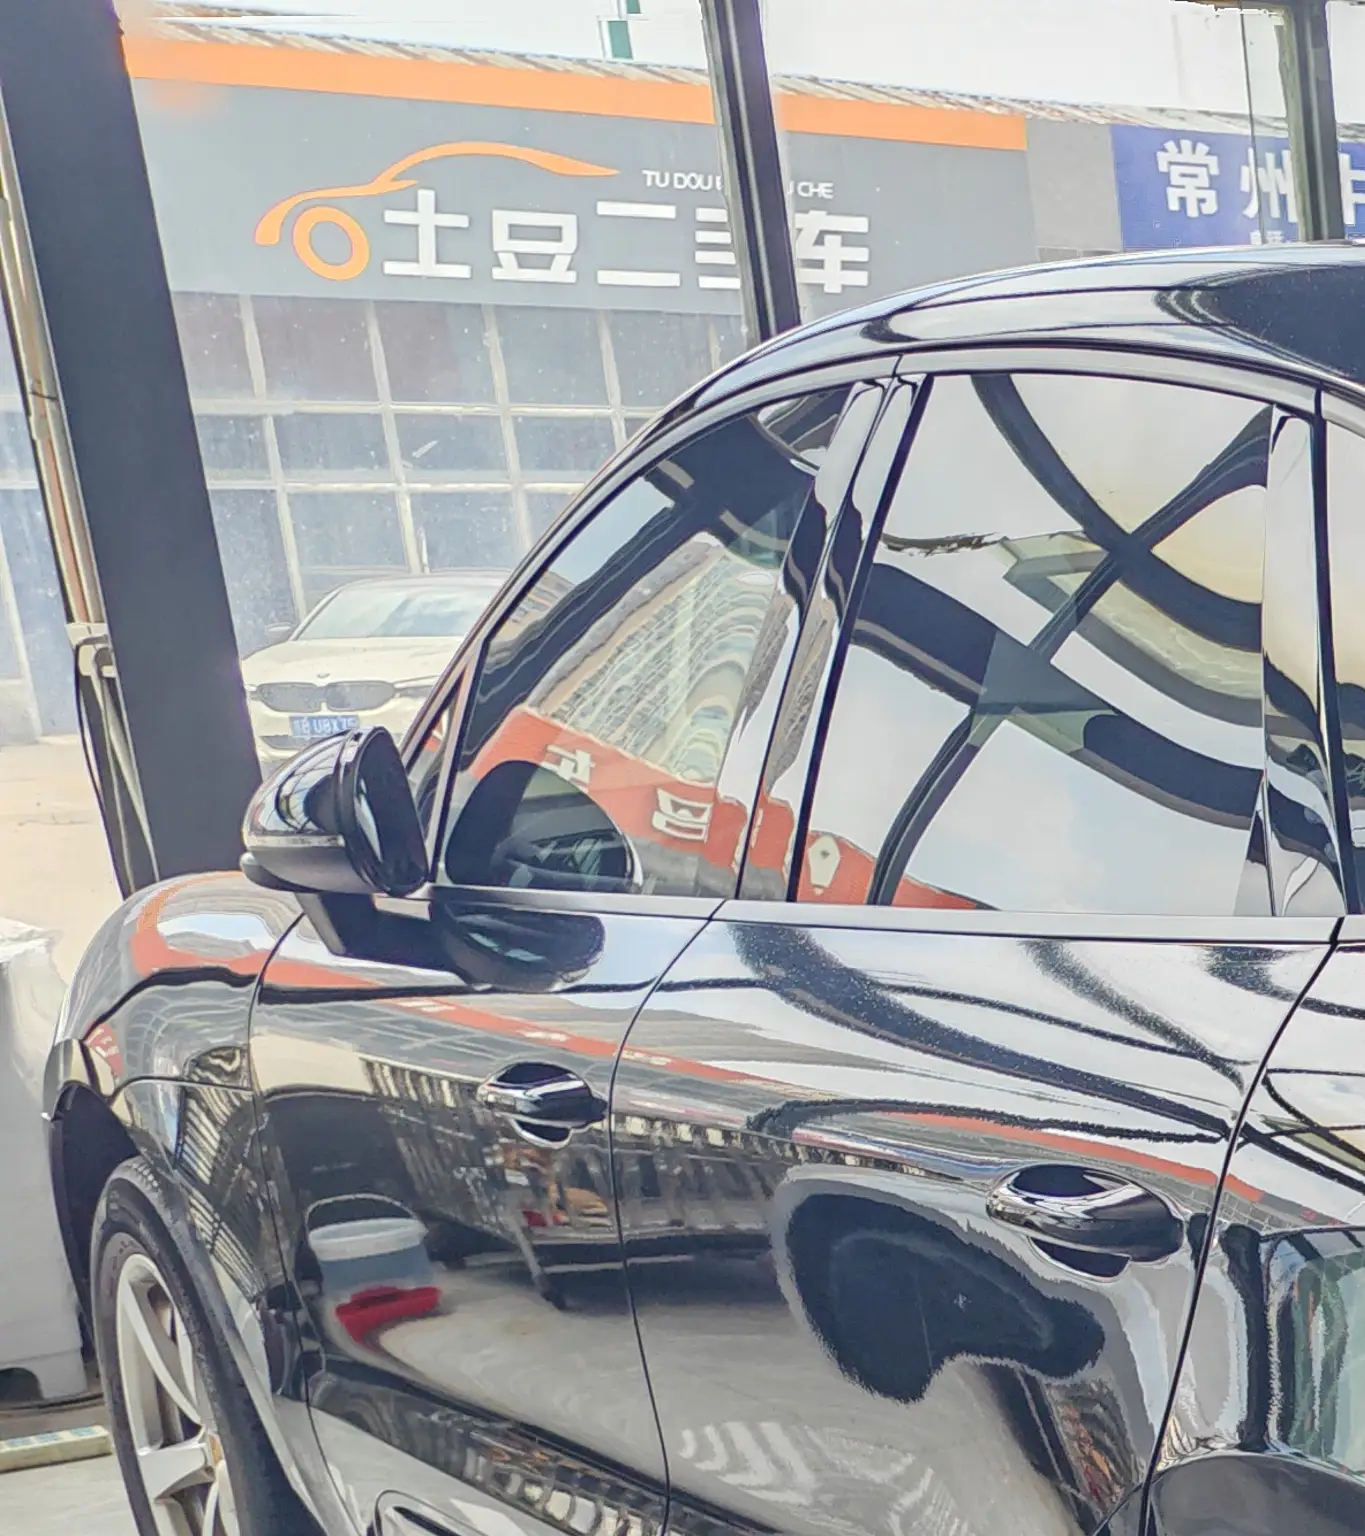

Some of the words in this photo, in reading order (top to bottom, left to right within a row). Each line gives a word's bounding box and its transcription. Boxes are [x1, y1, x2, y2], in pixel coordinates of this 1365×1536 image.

[641, 169, 670, 188] TU
[672, 171, 713, 191] DOU
[796, 180, 835, 199] CHE
